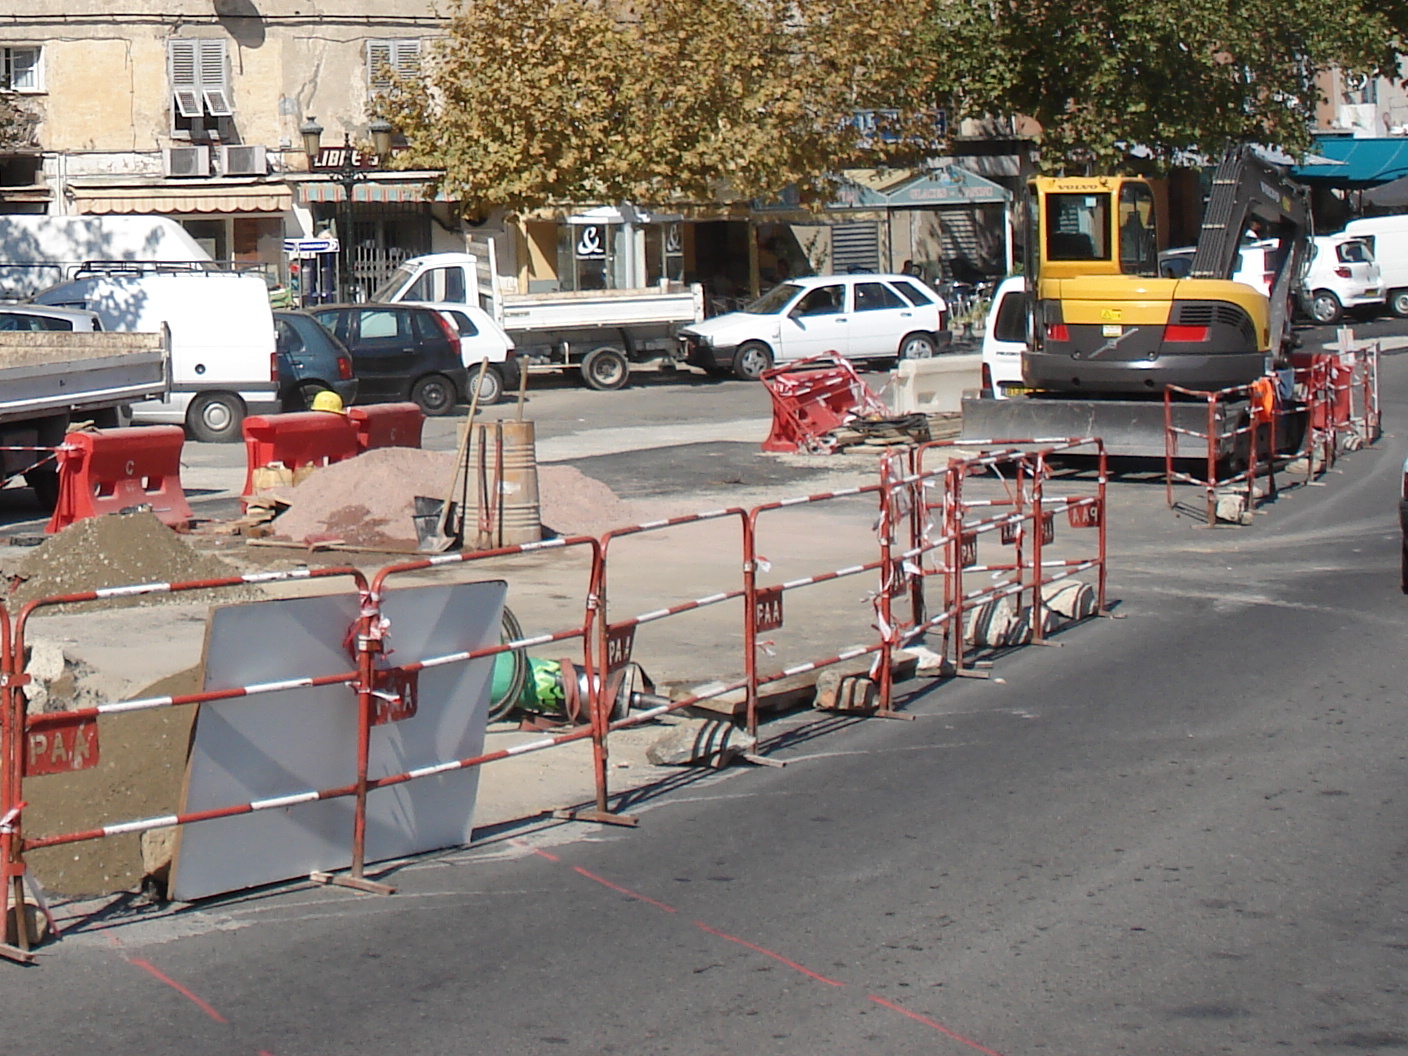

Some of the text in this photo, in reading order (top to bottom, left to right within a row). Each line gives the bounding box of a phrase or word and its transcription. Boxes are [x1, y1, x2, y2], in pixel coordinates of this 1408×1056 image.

[756, 599, 781, 626] PAA
[608, 635, 631, 666] PAA
[30, 721, 91, 769] PAA
